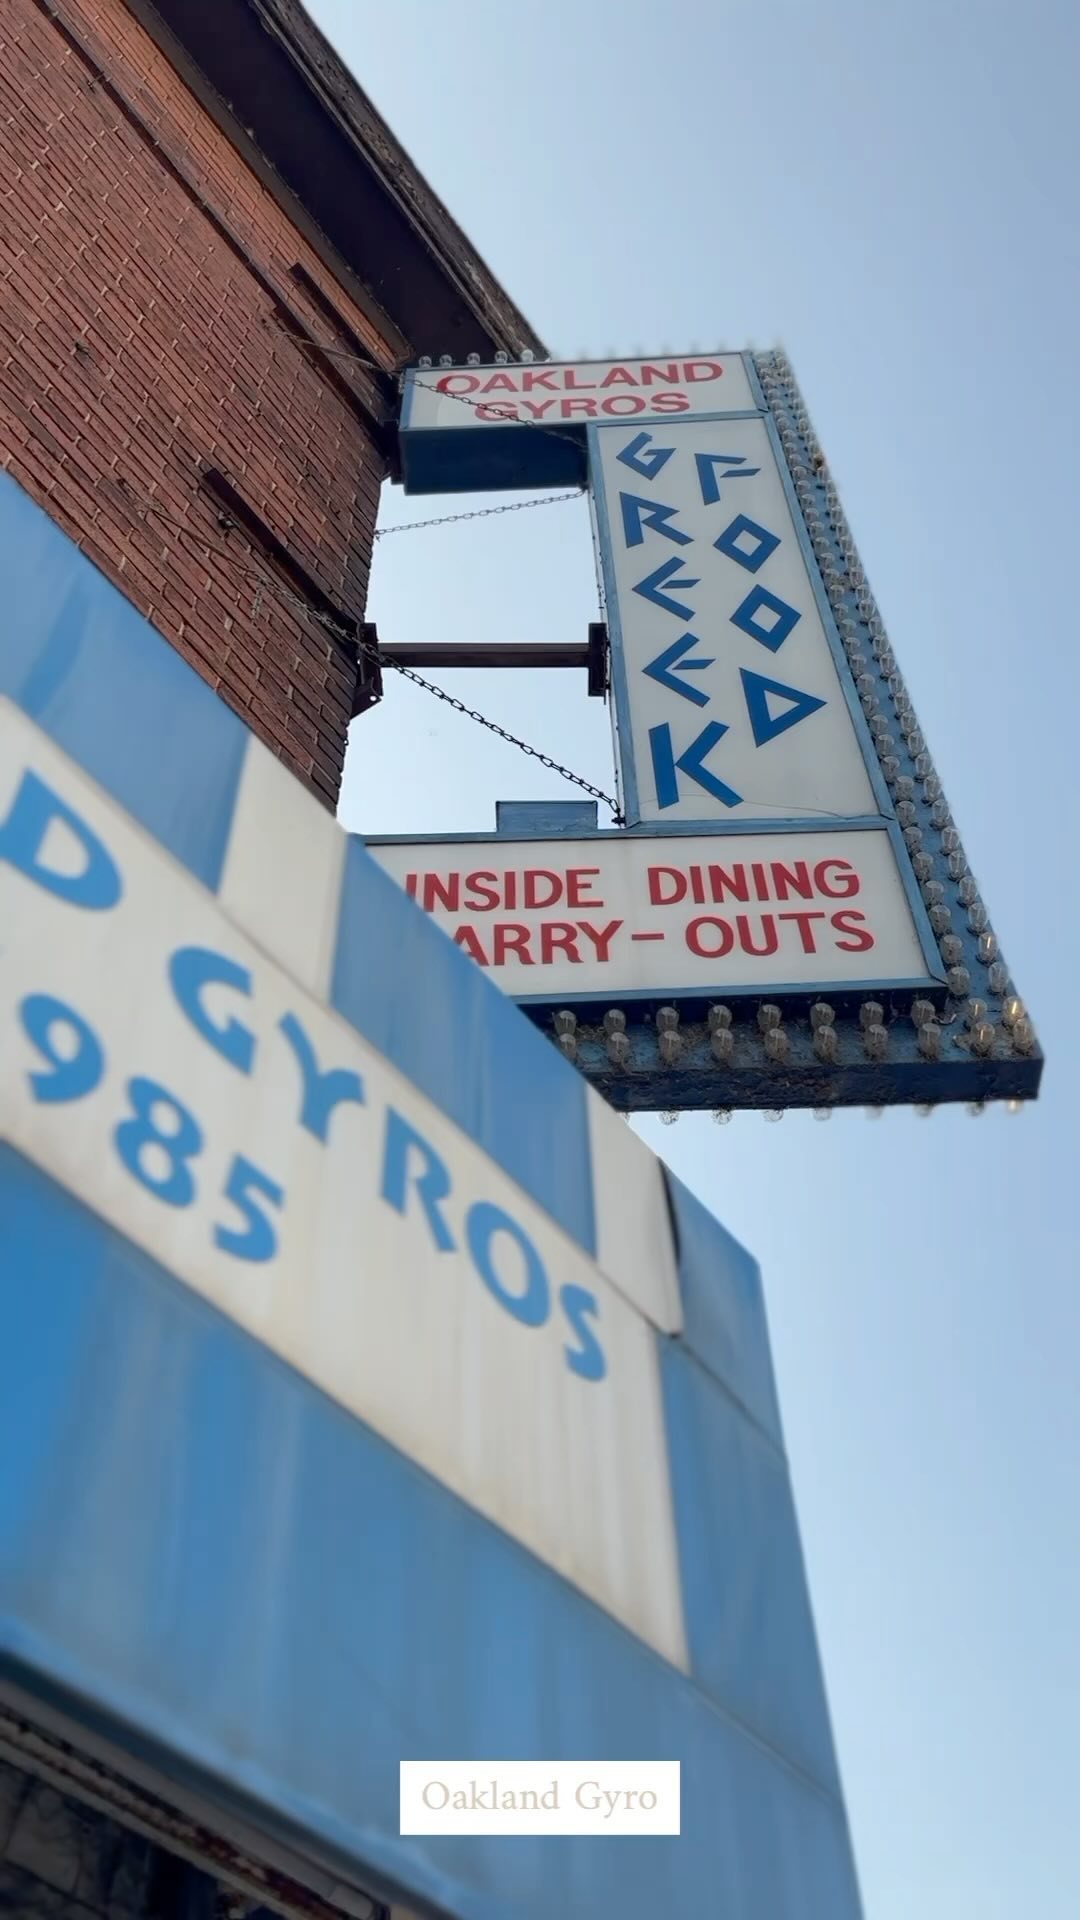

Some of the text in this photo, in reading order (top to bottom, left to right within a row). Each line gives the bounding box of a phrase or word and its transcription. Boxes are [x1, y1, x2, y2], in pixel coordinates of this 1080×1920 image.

[436, 361, 723, 395] OAKLAND
[474, 392, 690, 422] GYROS
[616, 431, 744, 810] GREEK
[694, 453, 827, 748] FOOD
[405, 858, 860, 913] INSIDE DINING
[167, 945, 608, 1382] GYROS
